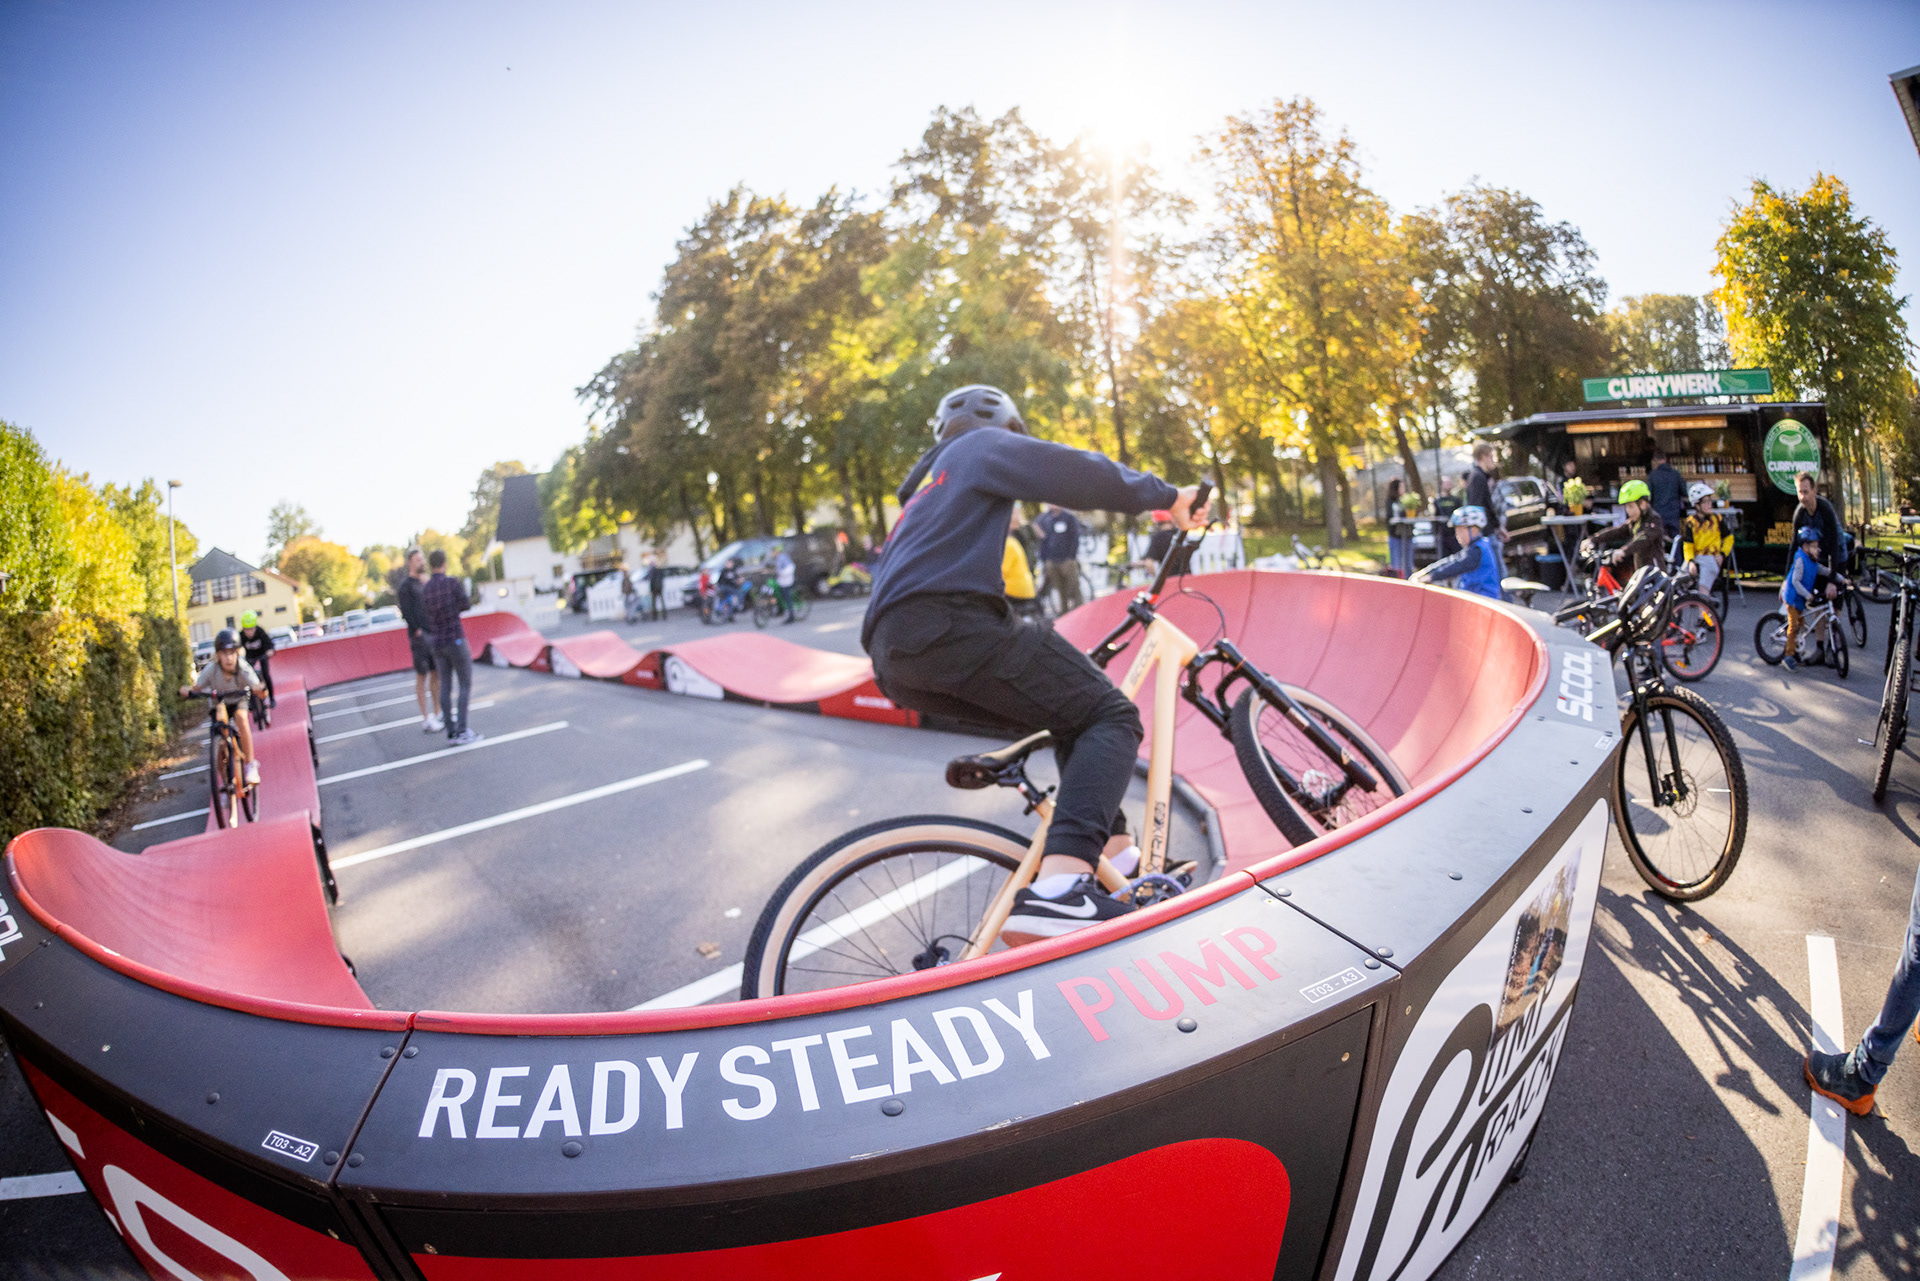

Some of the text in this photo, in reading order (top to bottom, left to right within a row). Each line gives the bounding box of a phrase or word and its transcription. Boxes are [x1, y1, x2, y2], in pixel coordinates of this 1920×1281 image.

[1608, 373, 1723, 399] CURRYWERK
[1308, 983, 1334, 998] T03
[1341, 972, 1358, 985] A3
[418, 926, 1282, 1138] READY STEADY PUMP
[270, 1135, 290, 1149] T03
[294, 1145, 311, 1157] A2
